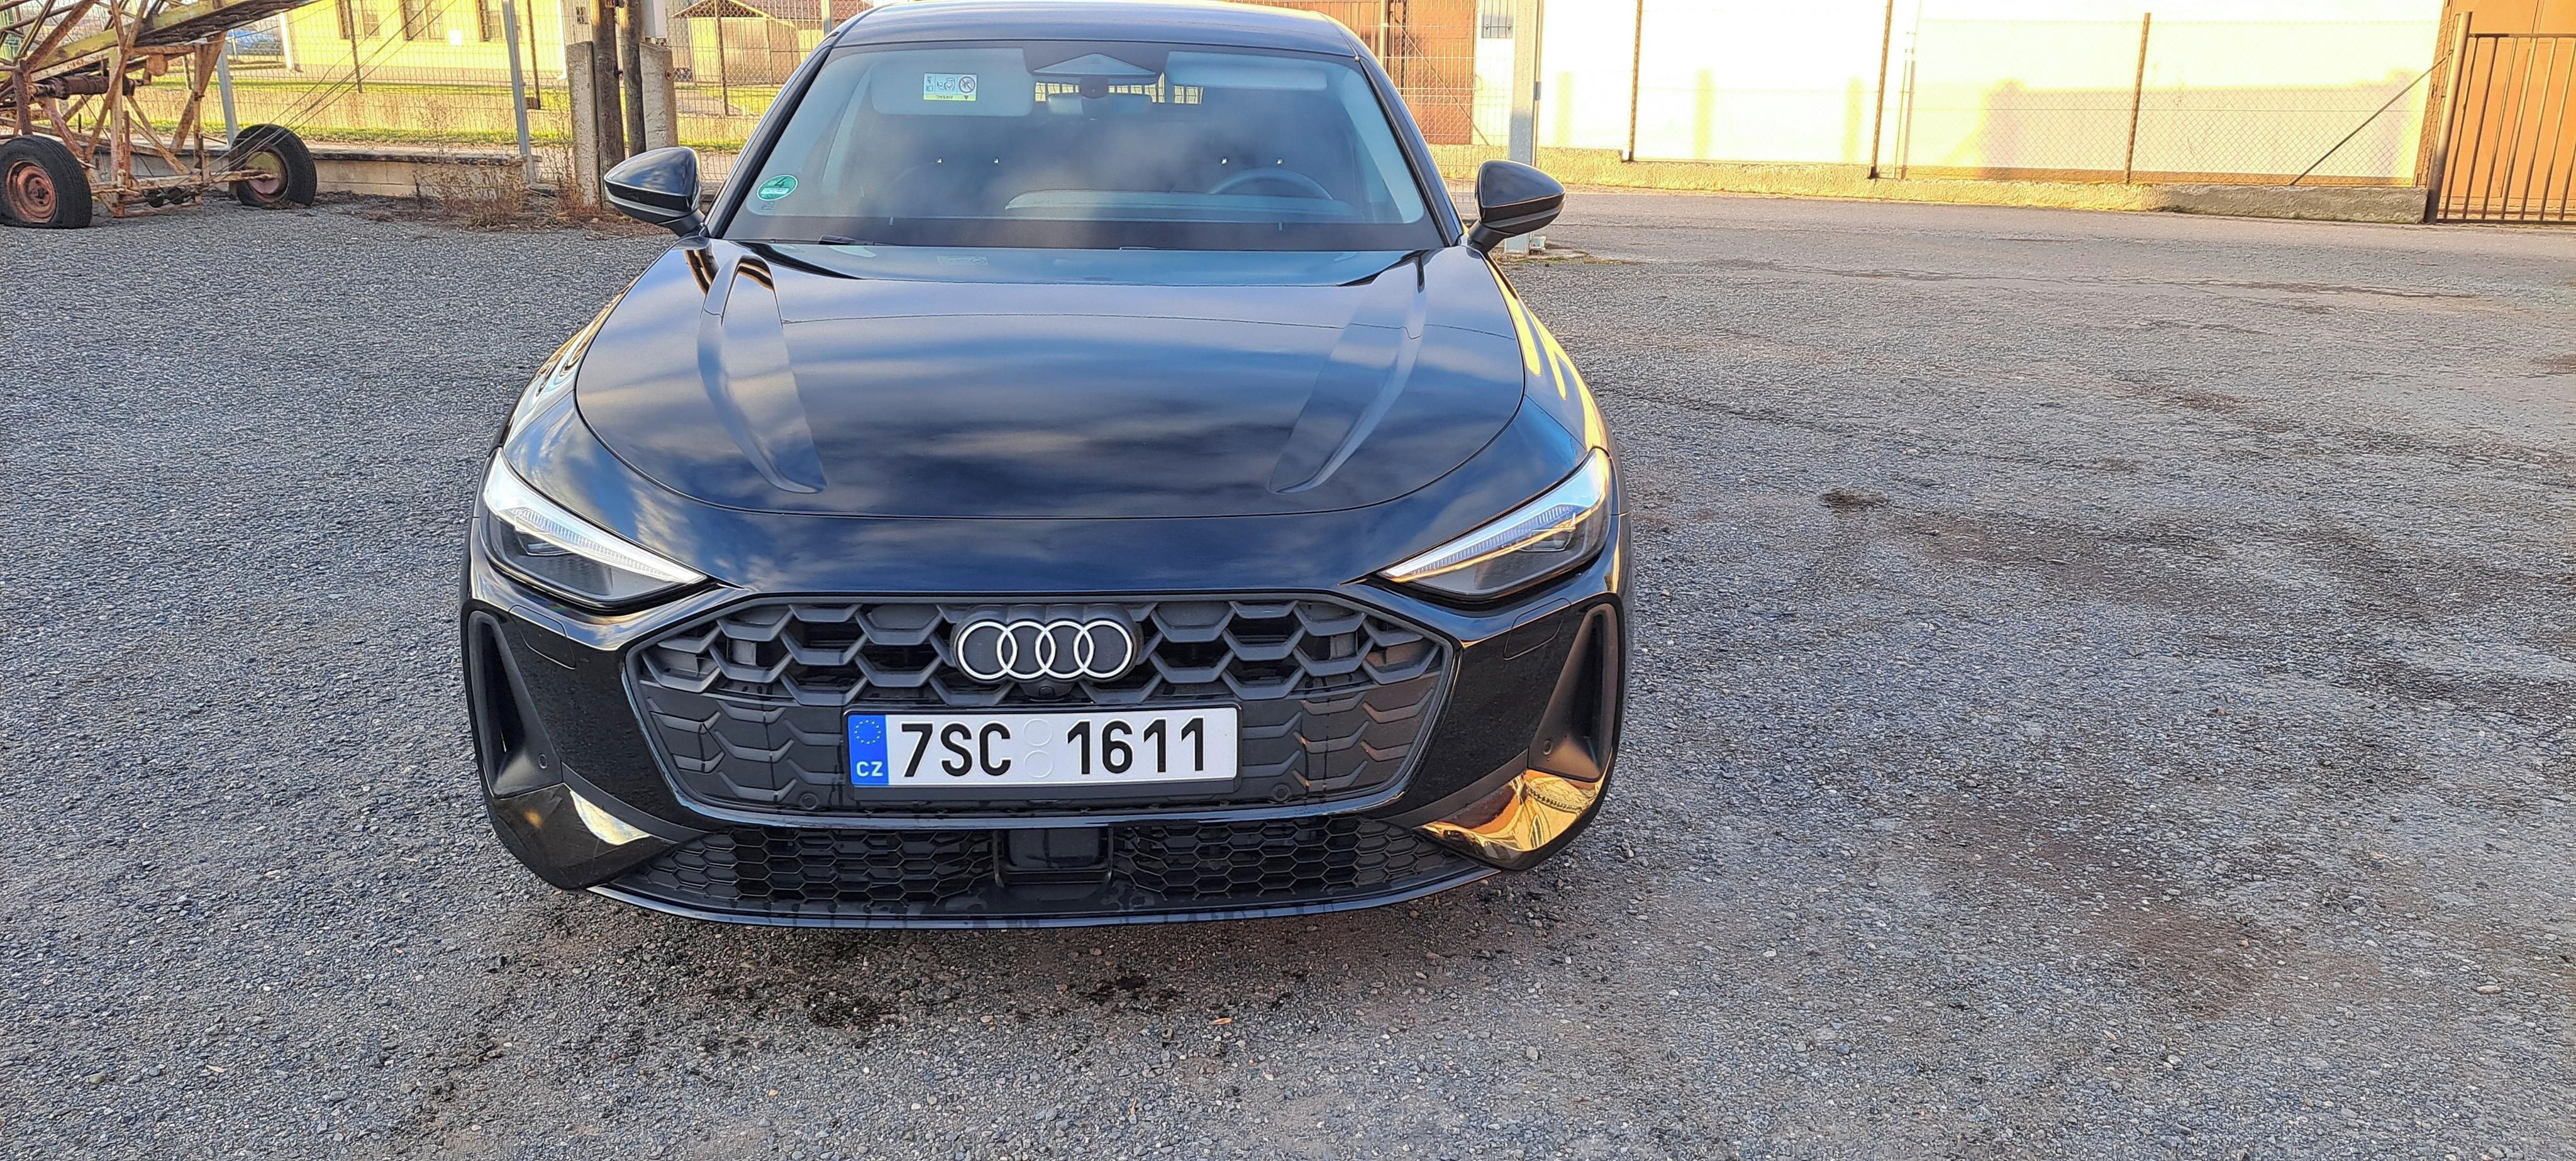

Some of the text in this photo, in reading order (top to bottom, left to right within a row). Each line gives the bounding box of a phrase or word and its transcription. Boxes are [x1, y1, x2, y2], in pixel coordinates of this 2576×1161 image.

[774, 177, 787, 188] 4
[901, 717, 1204, 777] 7SC 1611
[856, 761, 884, 777] CZ
